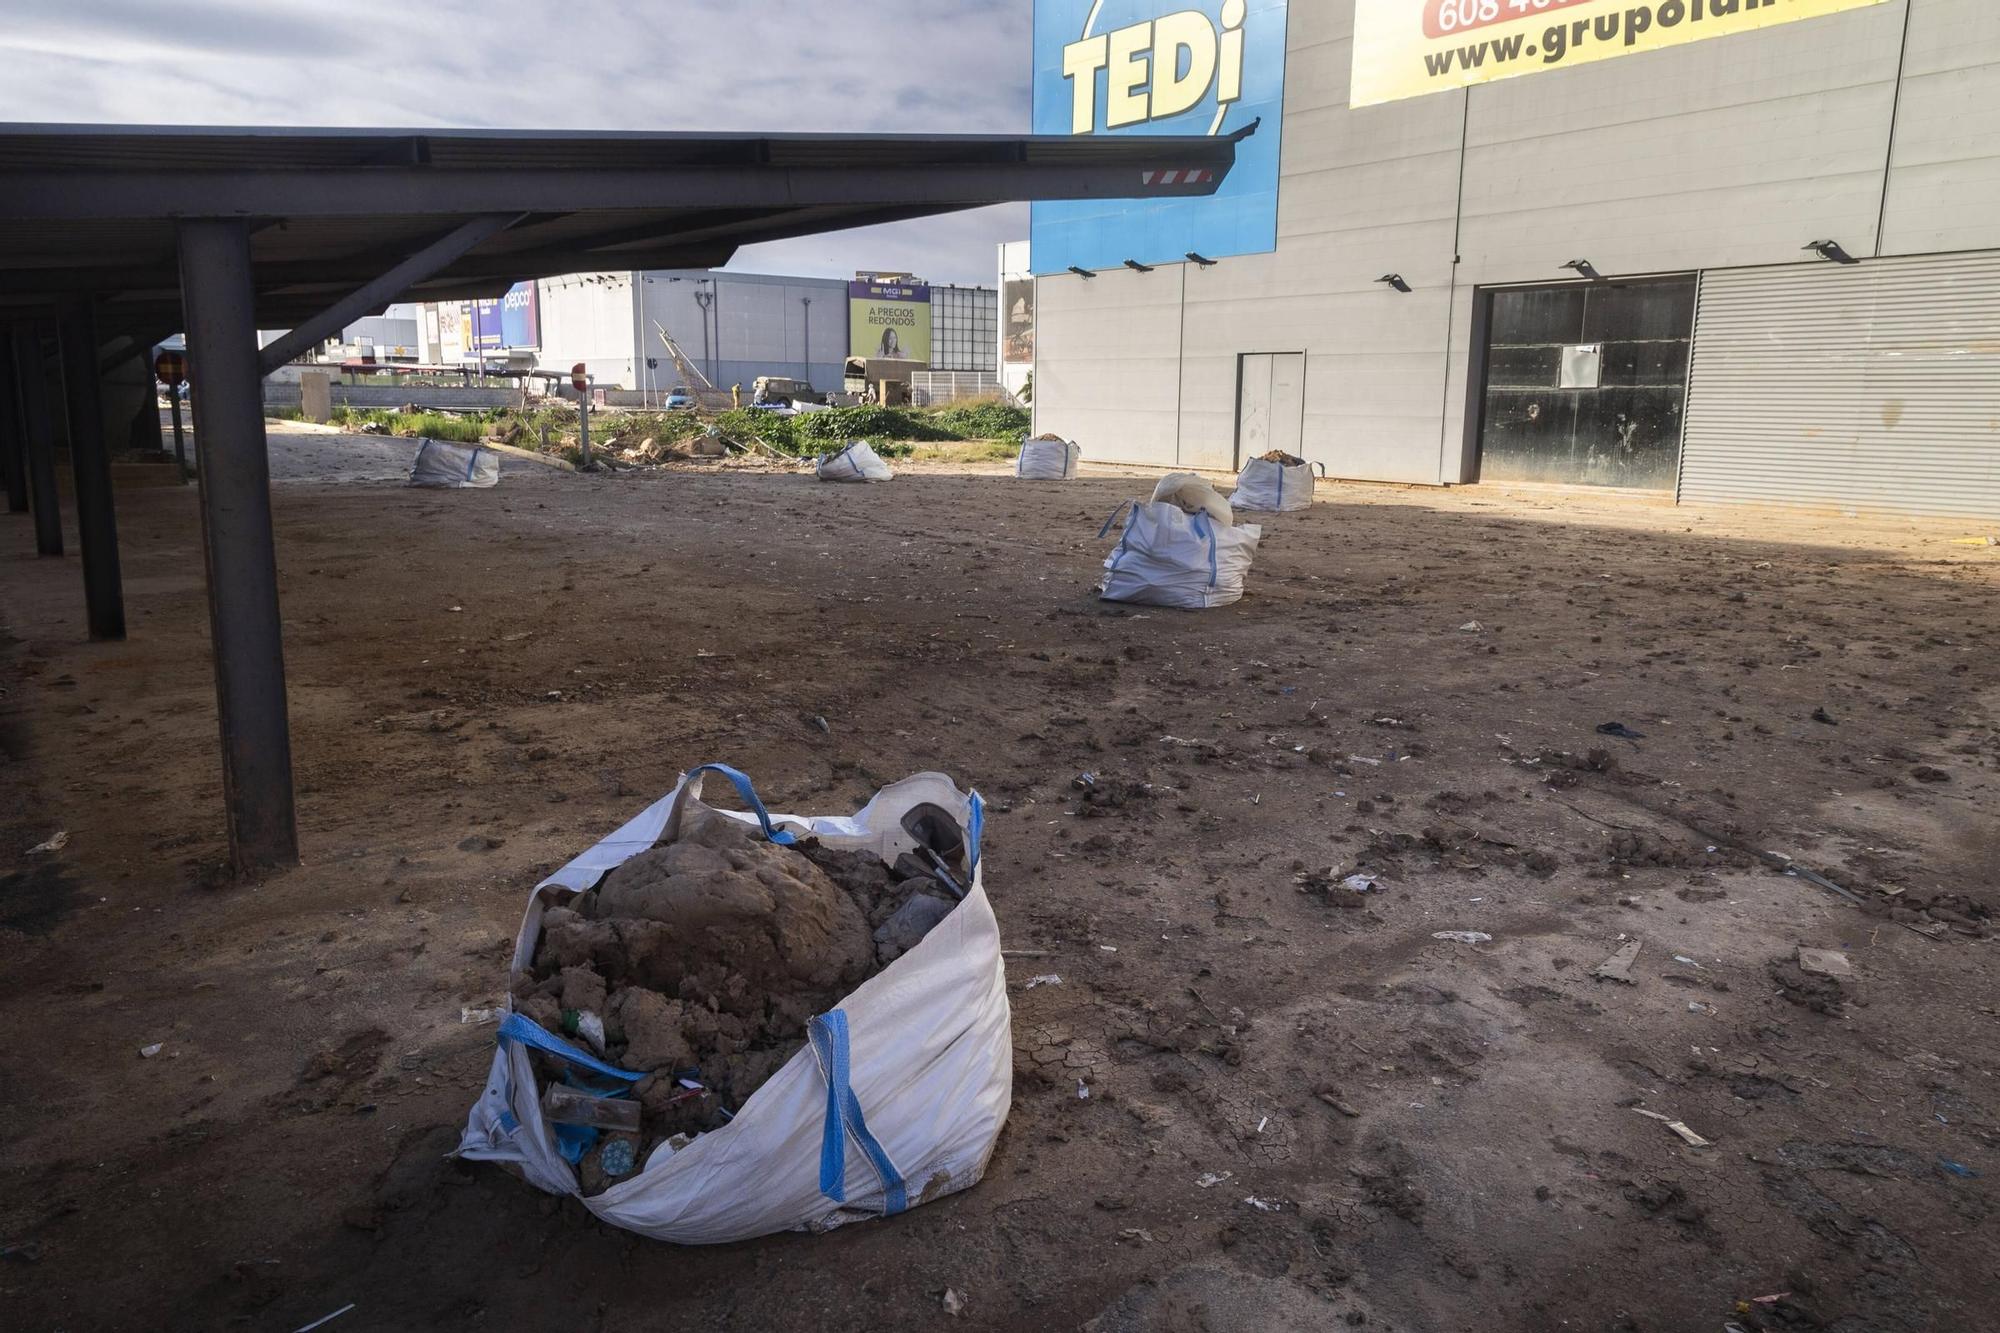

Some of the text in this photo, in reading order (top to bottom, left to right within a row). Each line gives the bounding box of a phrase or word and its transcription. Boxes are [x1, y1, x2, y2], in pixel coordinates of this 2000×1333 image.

[1063, 0, 1246, 135] TEDi
[869, 307, 914, 318] A PRECIOS
[868, 316, 915, 326] REDONDOS
